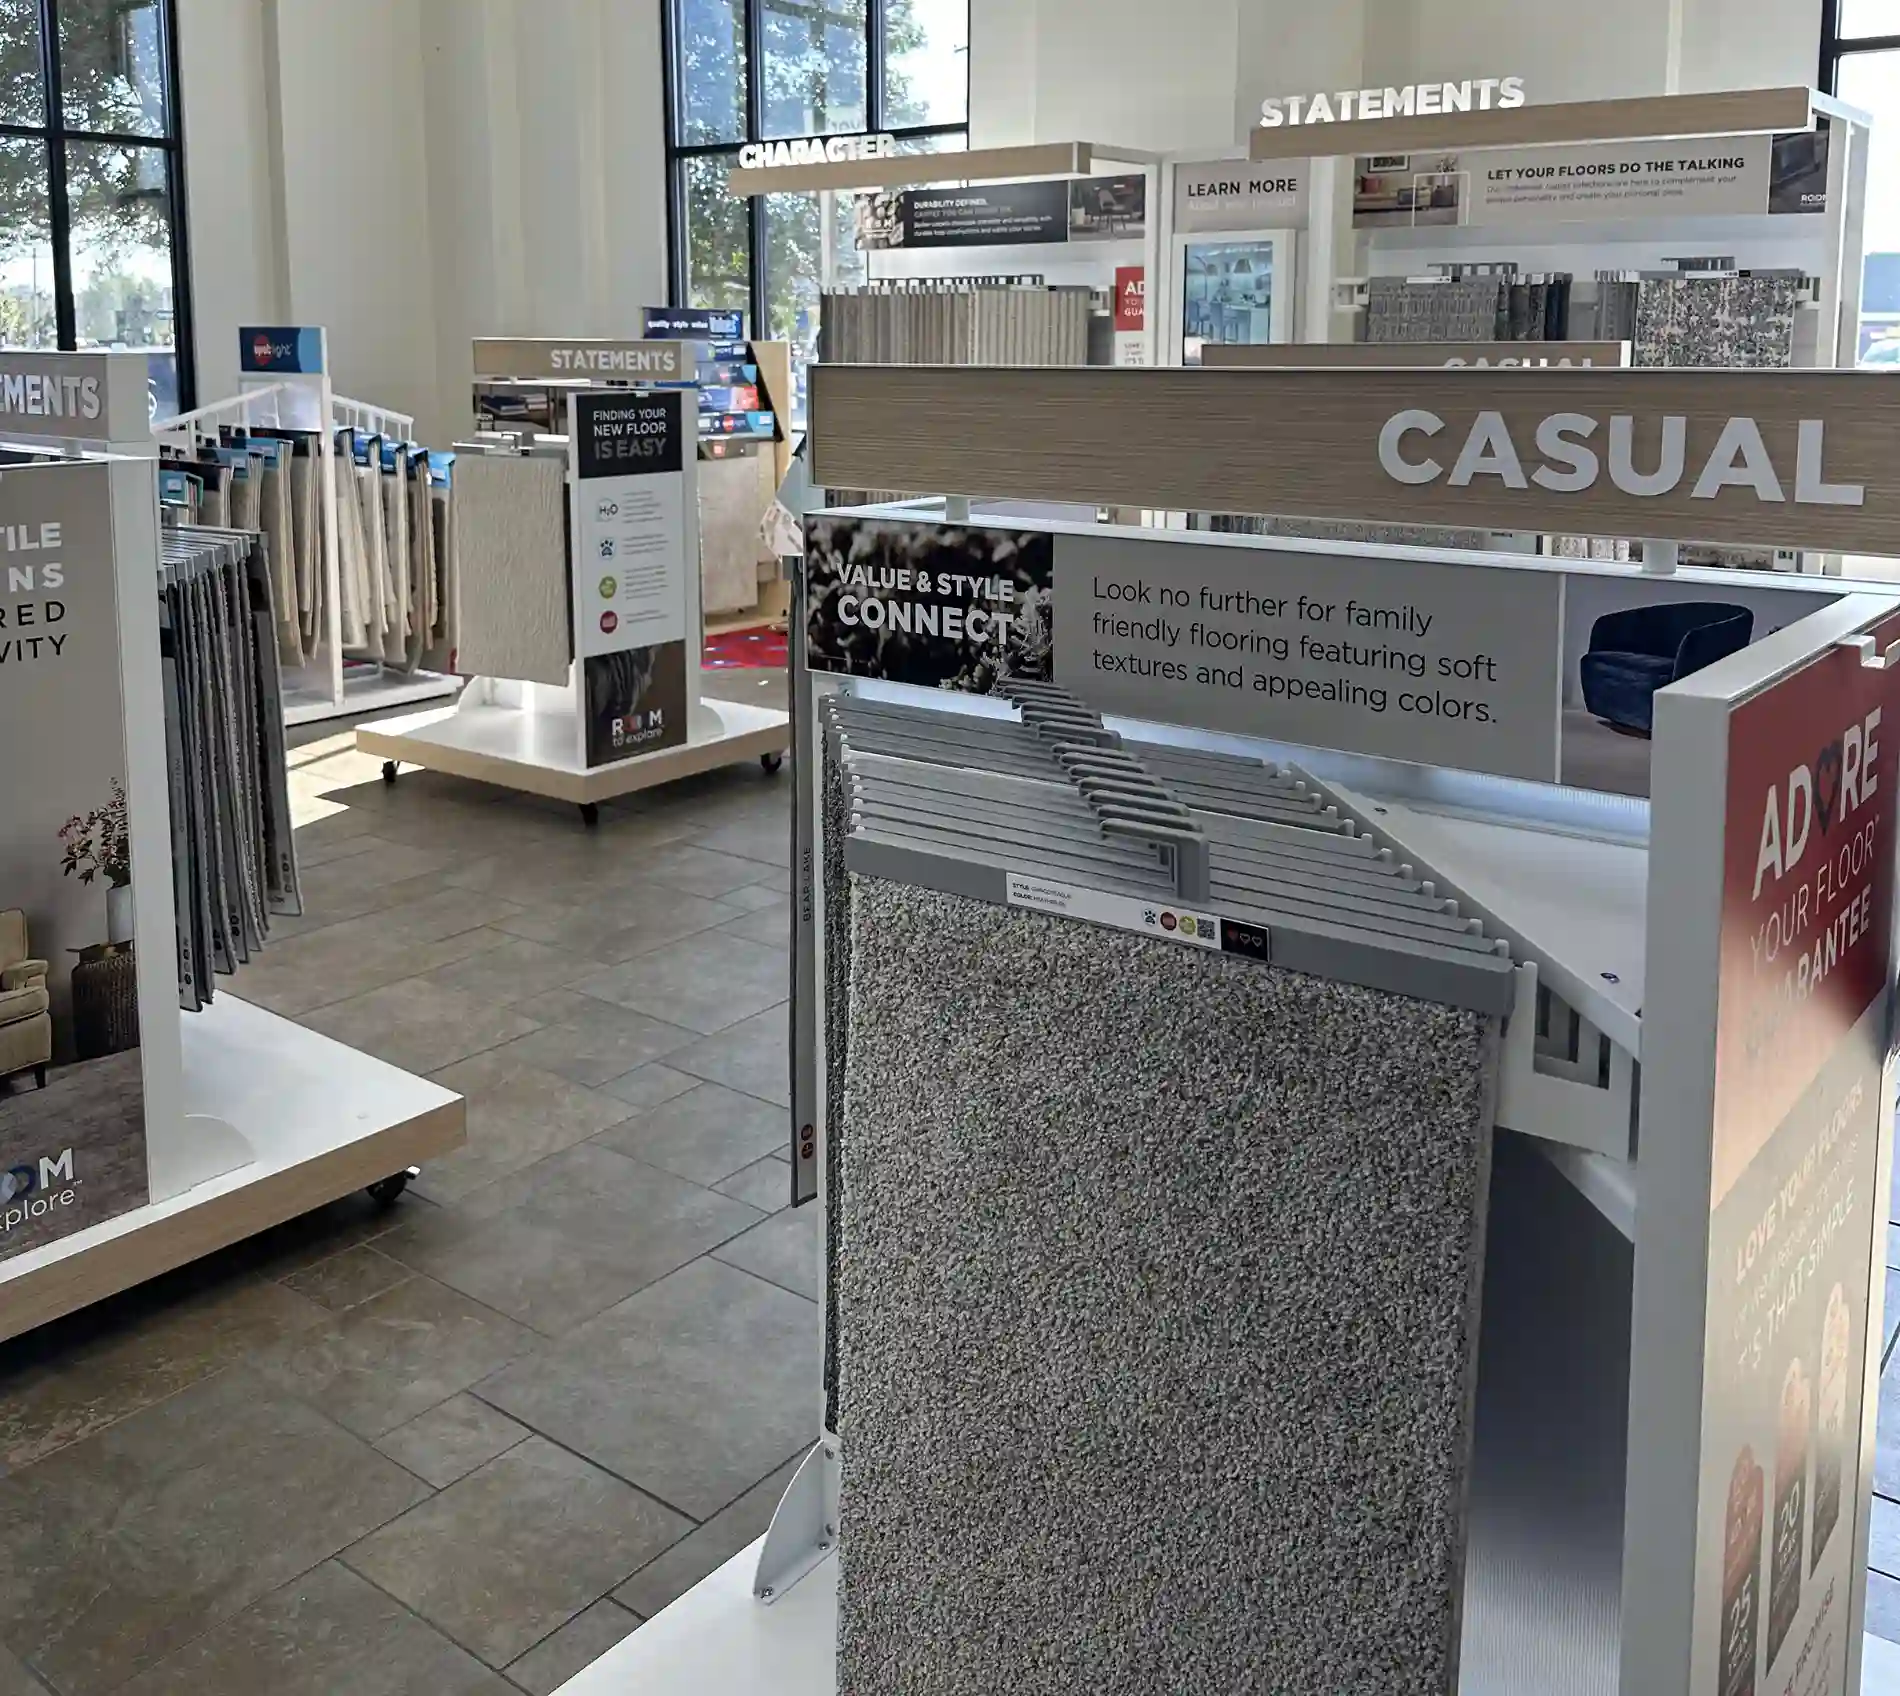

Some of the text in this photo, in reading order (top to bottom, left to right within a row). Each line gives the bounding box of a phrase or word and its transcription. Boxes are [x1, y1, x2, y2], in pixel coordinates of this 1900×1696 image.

[1259, 77, 1525, 127] STATEMENTS
[739, 133, 896, 169] CHARACTER
[1488, 157, 1745, 180] LET YOUR FLOORS DO THE TALKING
[914, 199, 954, 209] DURABILITY
[1188, 178, 1297, 197] LEARN MORE
[551, 349, 675, 371] STATEMENTS
[593, 408, 667, 421] FINDING YOUR
[593, 421, 667, 437] NEW FLOOR
[595, 438, 667, 460] IS EASY
[1378, 409, 1865, 506] CASUAL
[0, 522, 62, 552] ILE
[837, 563, 1014, 602] VALUE & STYLE
[1093, 576, 1432, 637] Look no further for family
[837, 594, 1014, 645] CONNECT
[1093, 612, 1497, 682] friendly flooring featuring soft
[1093, 649, 1497, 723] textures and appealing colors.
[1751, 883, 1809, 977] YOUR
[1760, 883, 1872, 1030] ARANTEE
[0, 1189, 75, 1232] plore
[1737, 1200, 1776, 1284] LOVE
[1768, 1254, 1805, 1342] THAT
[1807, 1177, 1855, 1278] SIMPLE
[1778, 1479, 1799, 1553] 20
[1728, 1572, 1751, 1653] 25
